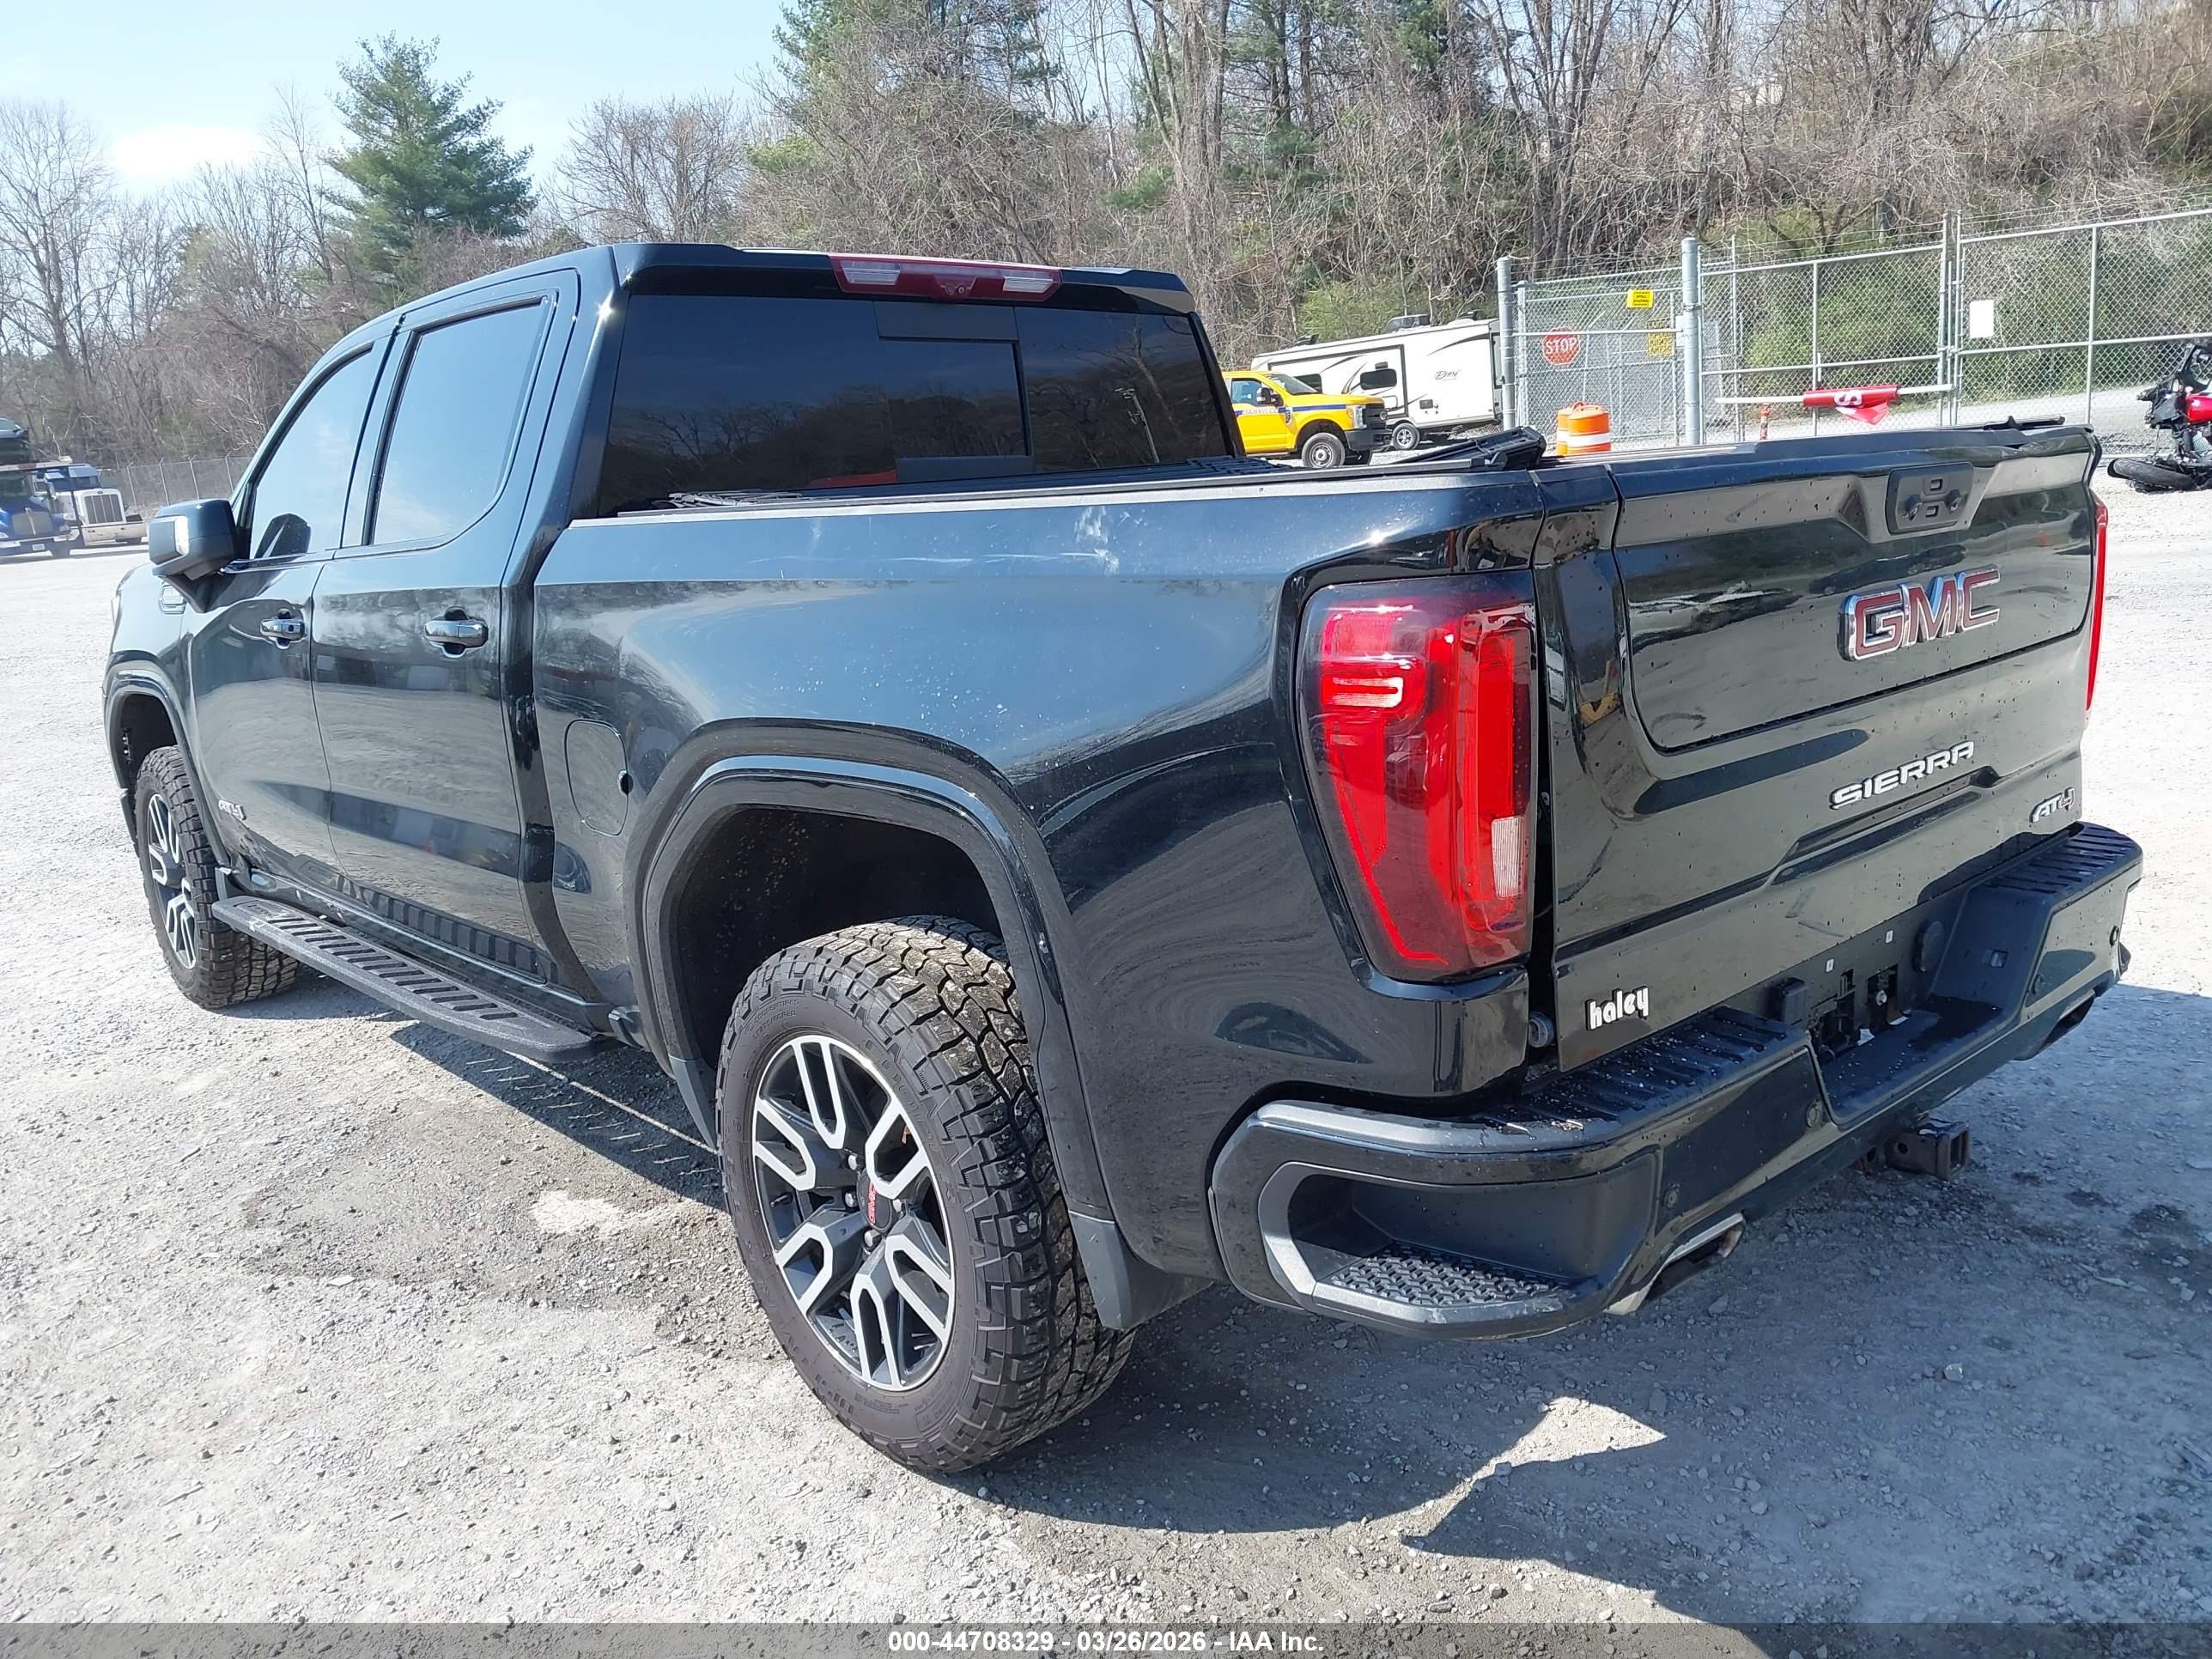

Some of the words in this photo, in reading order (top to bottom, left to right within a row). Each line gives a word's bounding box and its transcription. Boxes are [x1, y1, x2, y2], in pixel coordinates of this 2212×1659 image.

[1545, 337, 1578, 355] STOP
[1838, 564, 2001, 661] GMC
[1830, 740, 1974, 810] SIERRA
[1586, 986, 1649, 1030] haley
